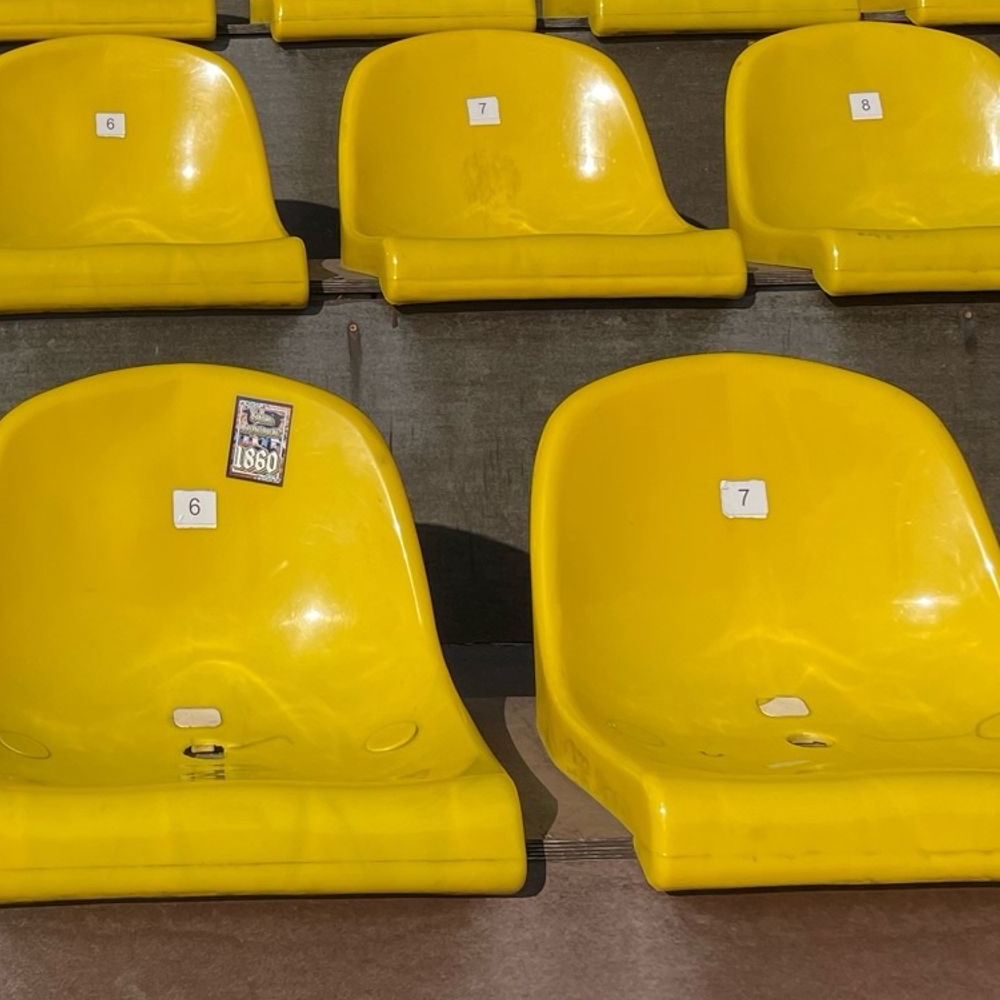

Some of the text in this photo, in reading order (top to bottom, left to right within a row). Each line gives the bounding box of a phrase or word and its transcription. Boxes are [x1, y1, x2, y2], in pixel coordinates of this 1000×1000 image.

[477, 102, 487, 115] 7
[861, 98, 871, 111] 8
[106, 117, 115, 130] 6
[233, 446, 278, 473] 1860
[737, 488, 750, 507] 7
[188, 497, 201, 516] 6
